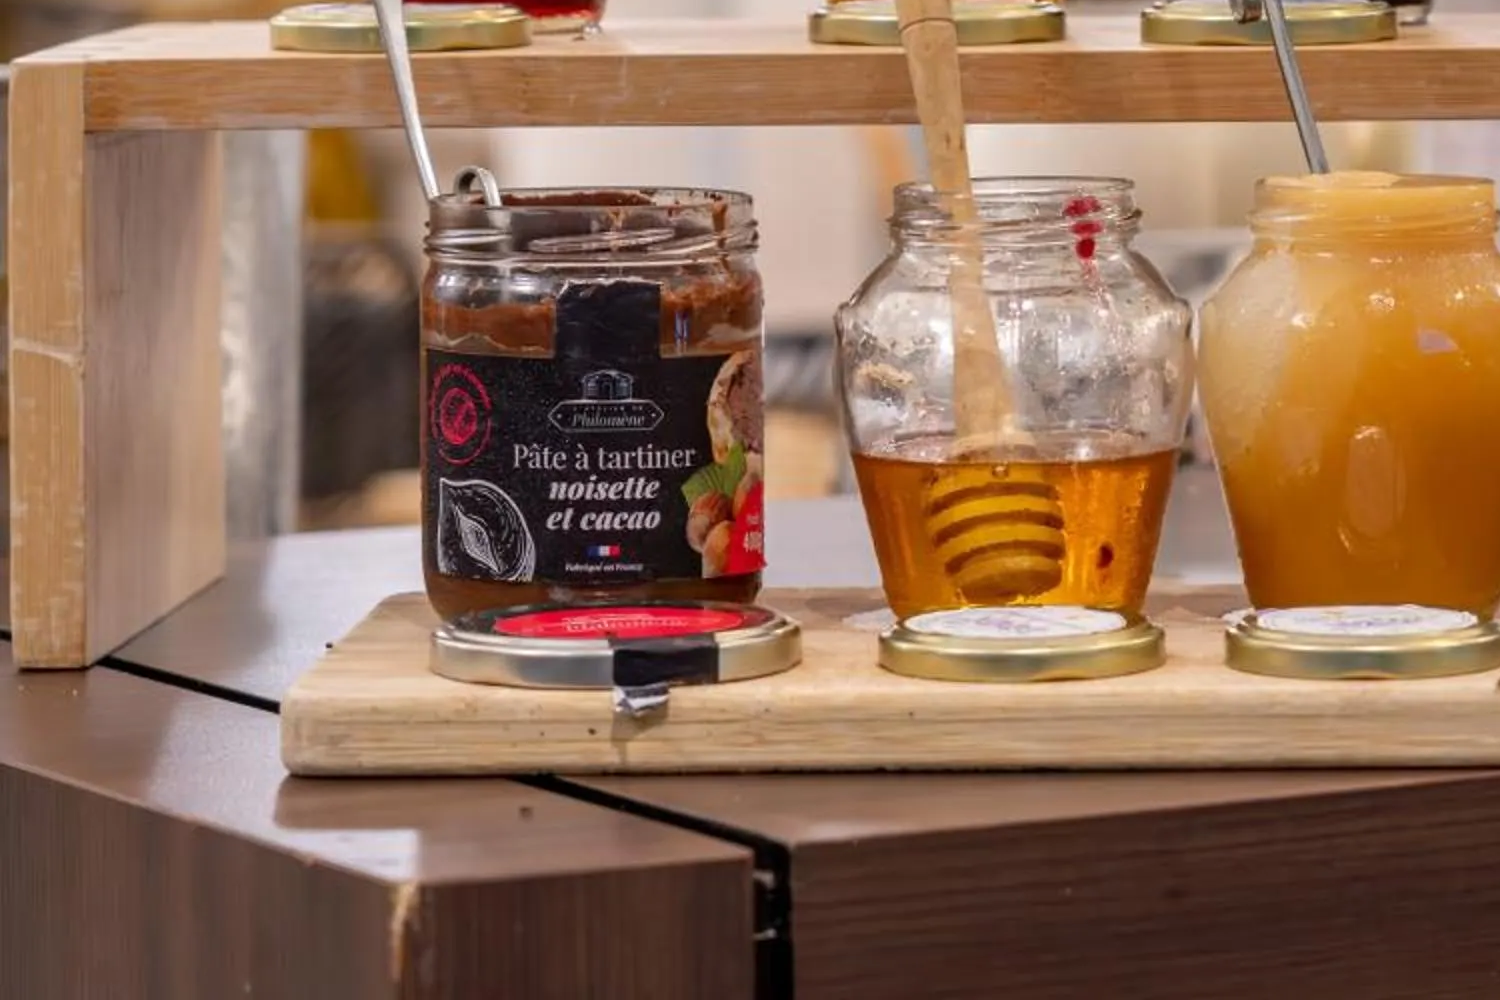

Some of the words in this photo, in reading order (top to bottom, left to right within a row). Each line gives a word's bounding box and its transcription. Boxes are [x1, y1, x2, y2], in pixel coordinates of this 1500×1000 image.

[513, 443, 567, 469] Pâte
[575, 444, 589, 469] à
[599, 444, 696, 469] tartiner
[549, 475, 660, 500] noisette
[546, 508, 574, 531] et
[580, 510, 661, 531] cacao
